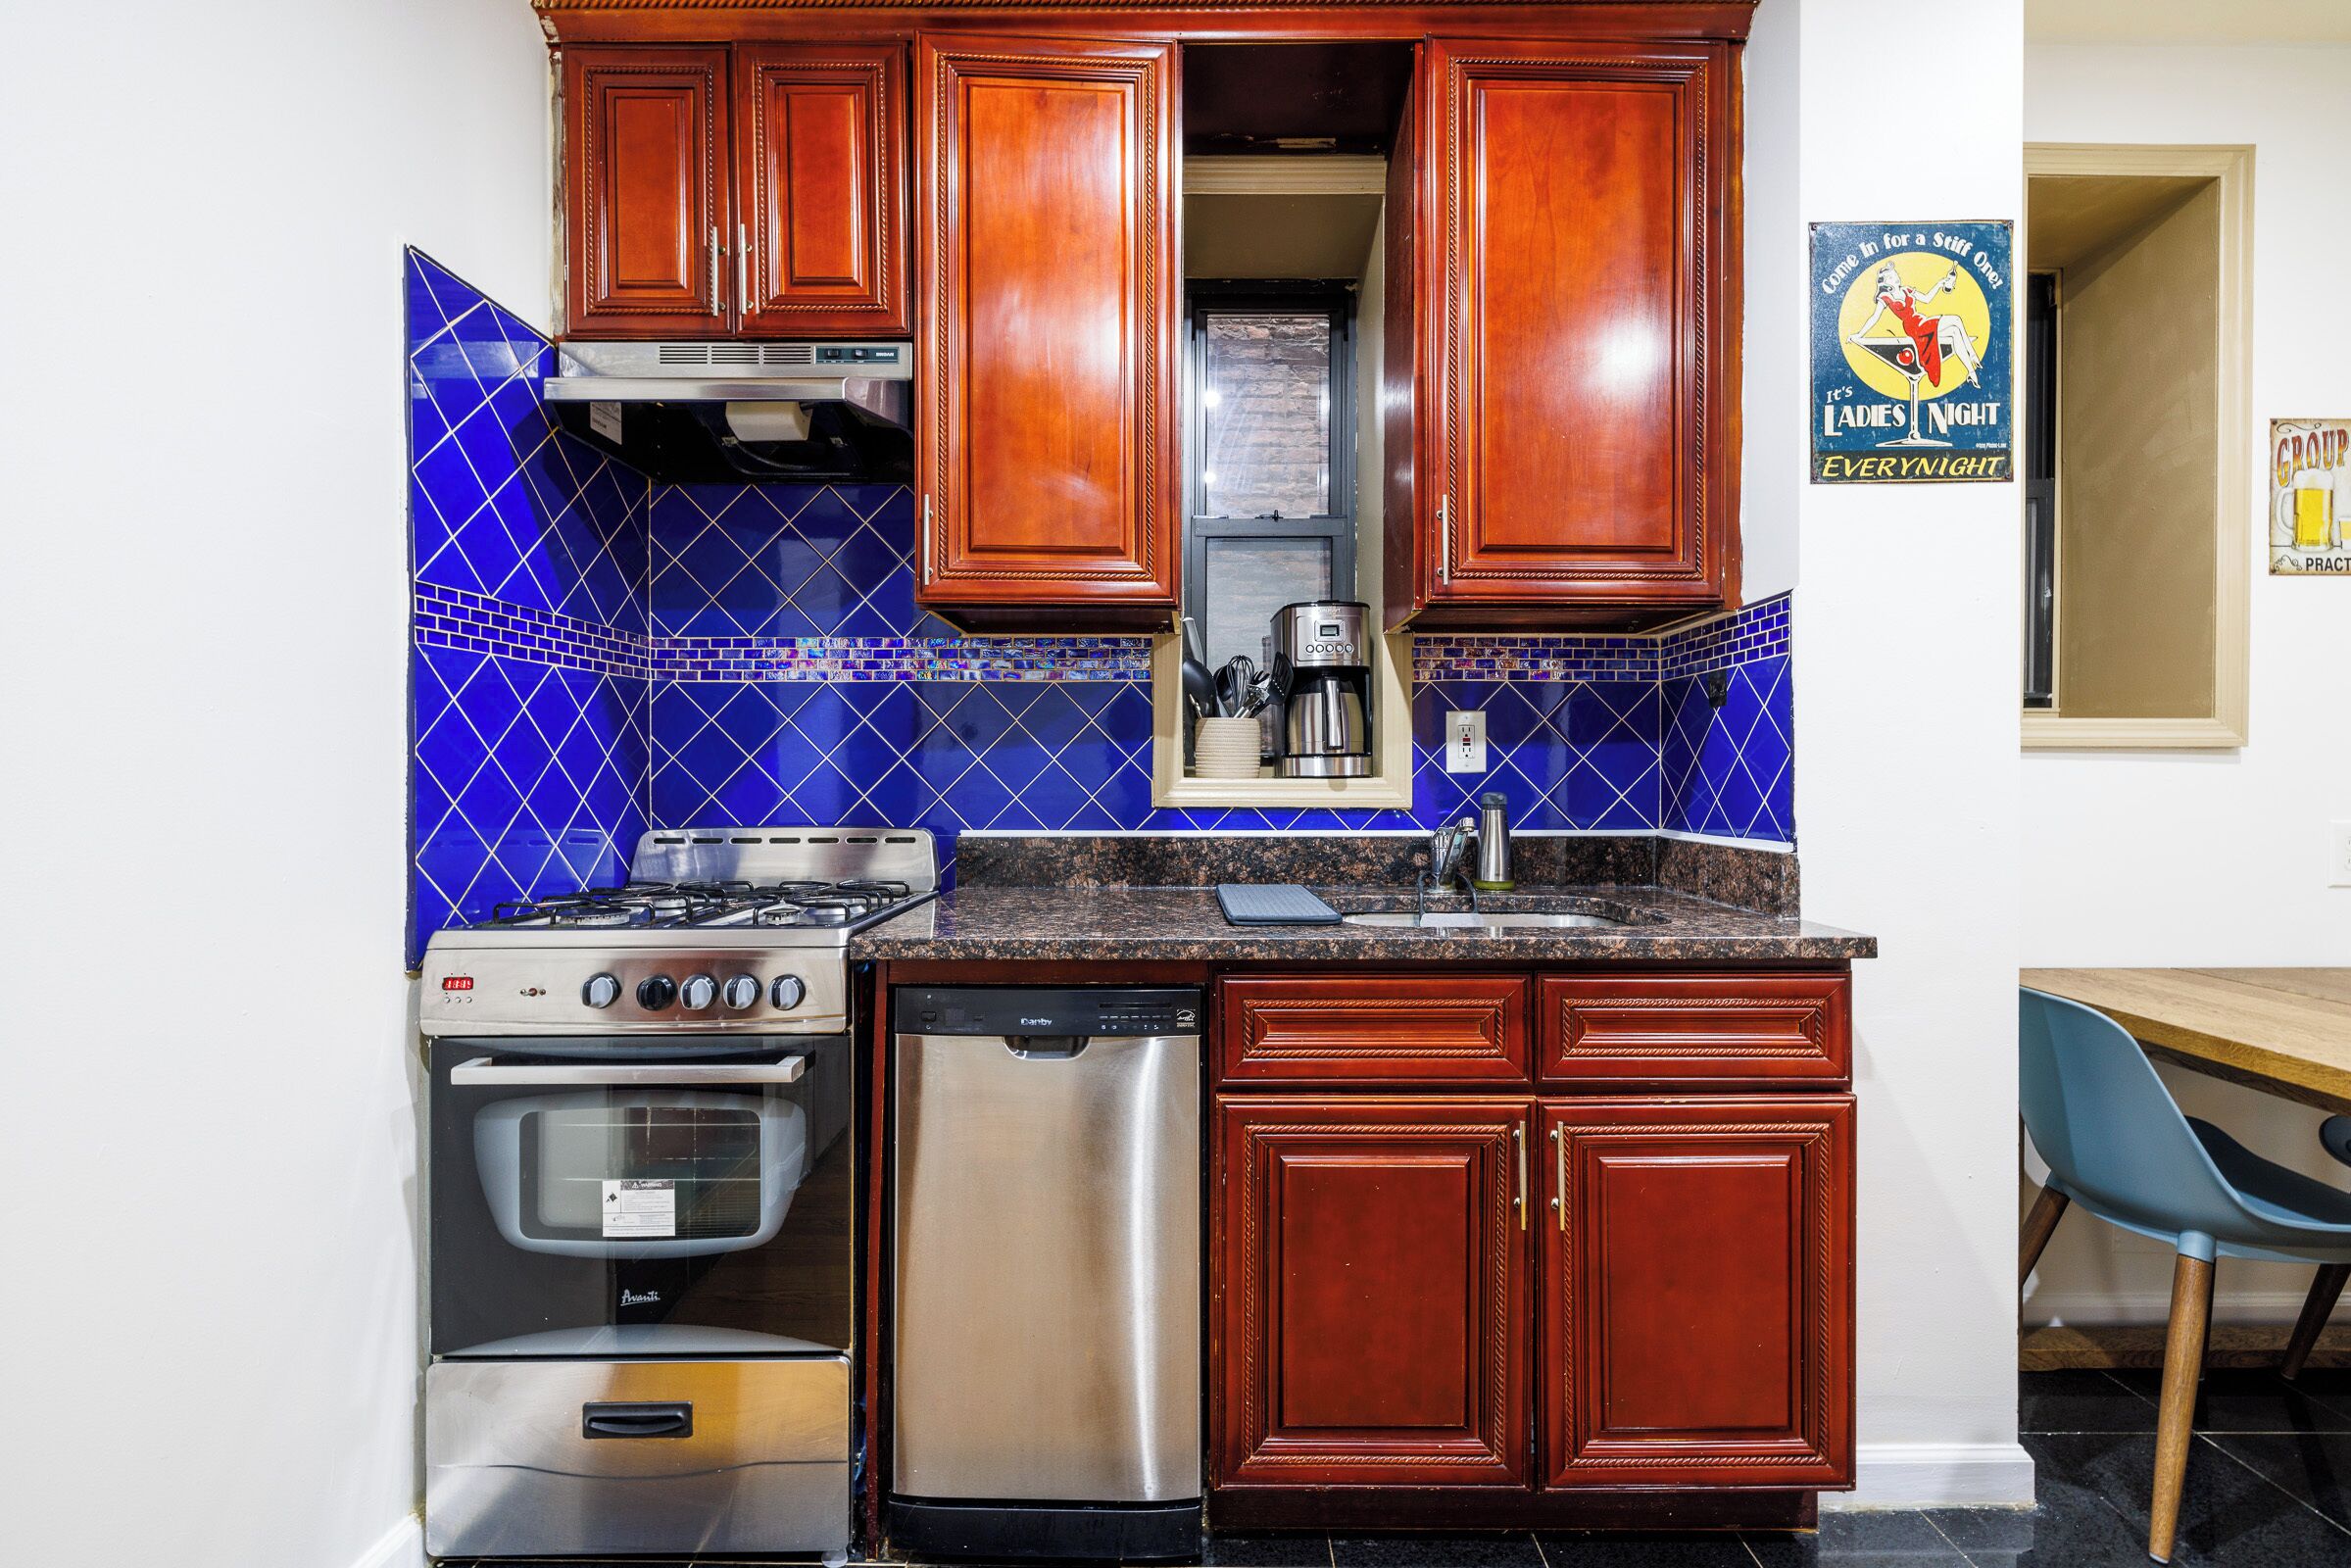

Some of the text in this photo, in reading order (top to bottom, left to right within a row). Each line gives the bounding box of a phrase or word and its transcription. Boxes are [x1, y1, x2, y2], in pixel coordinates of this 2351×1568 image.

[1822, 231, 2004, 294] Come In for a Stiff One!
[1826, 385, 1853, 404] It's
[1824, 403, 2001, 437] LADIES NIGHT
[1822, 455, 2006, 478] EVERYNIGHT
[2277, 428, 2350, 487] GROUP
[2306, 558, 2351, 571] PRACT
[620, 1289, 661, 1305] Avanti
